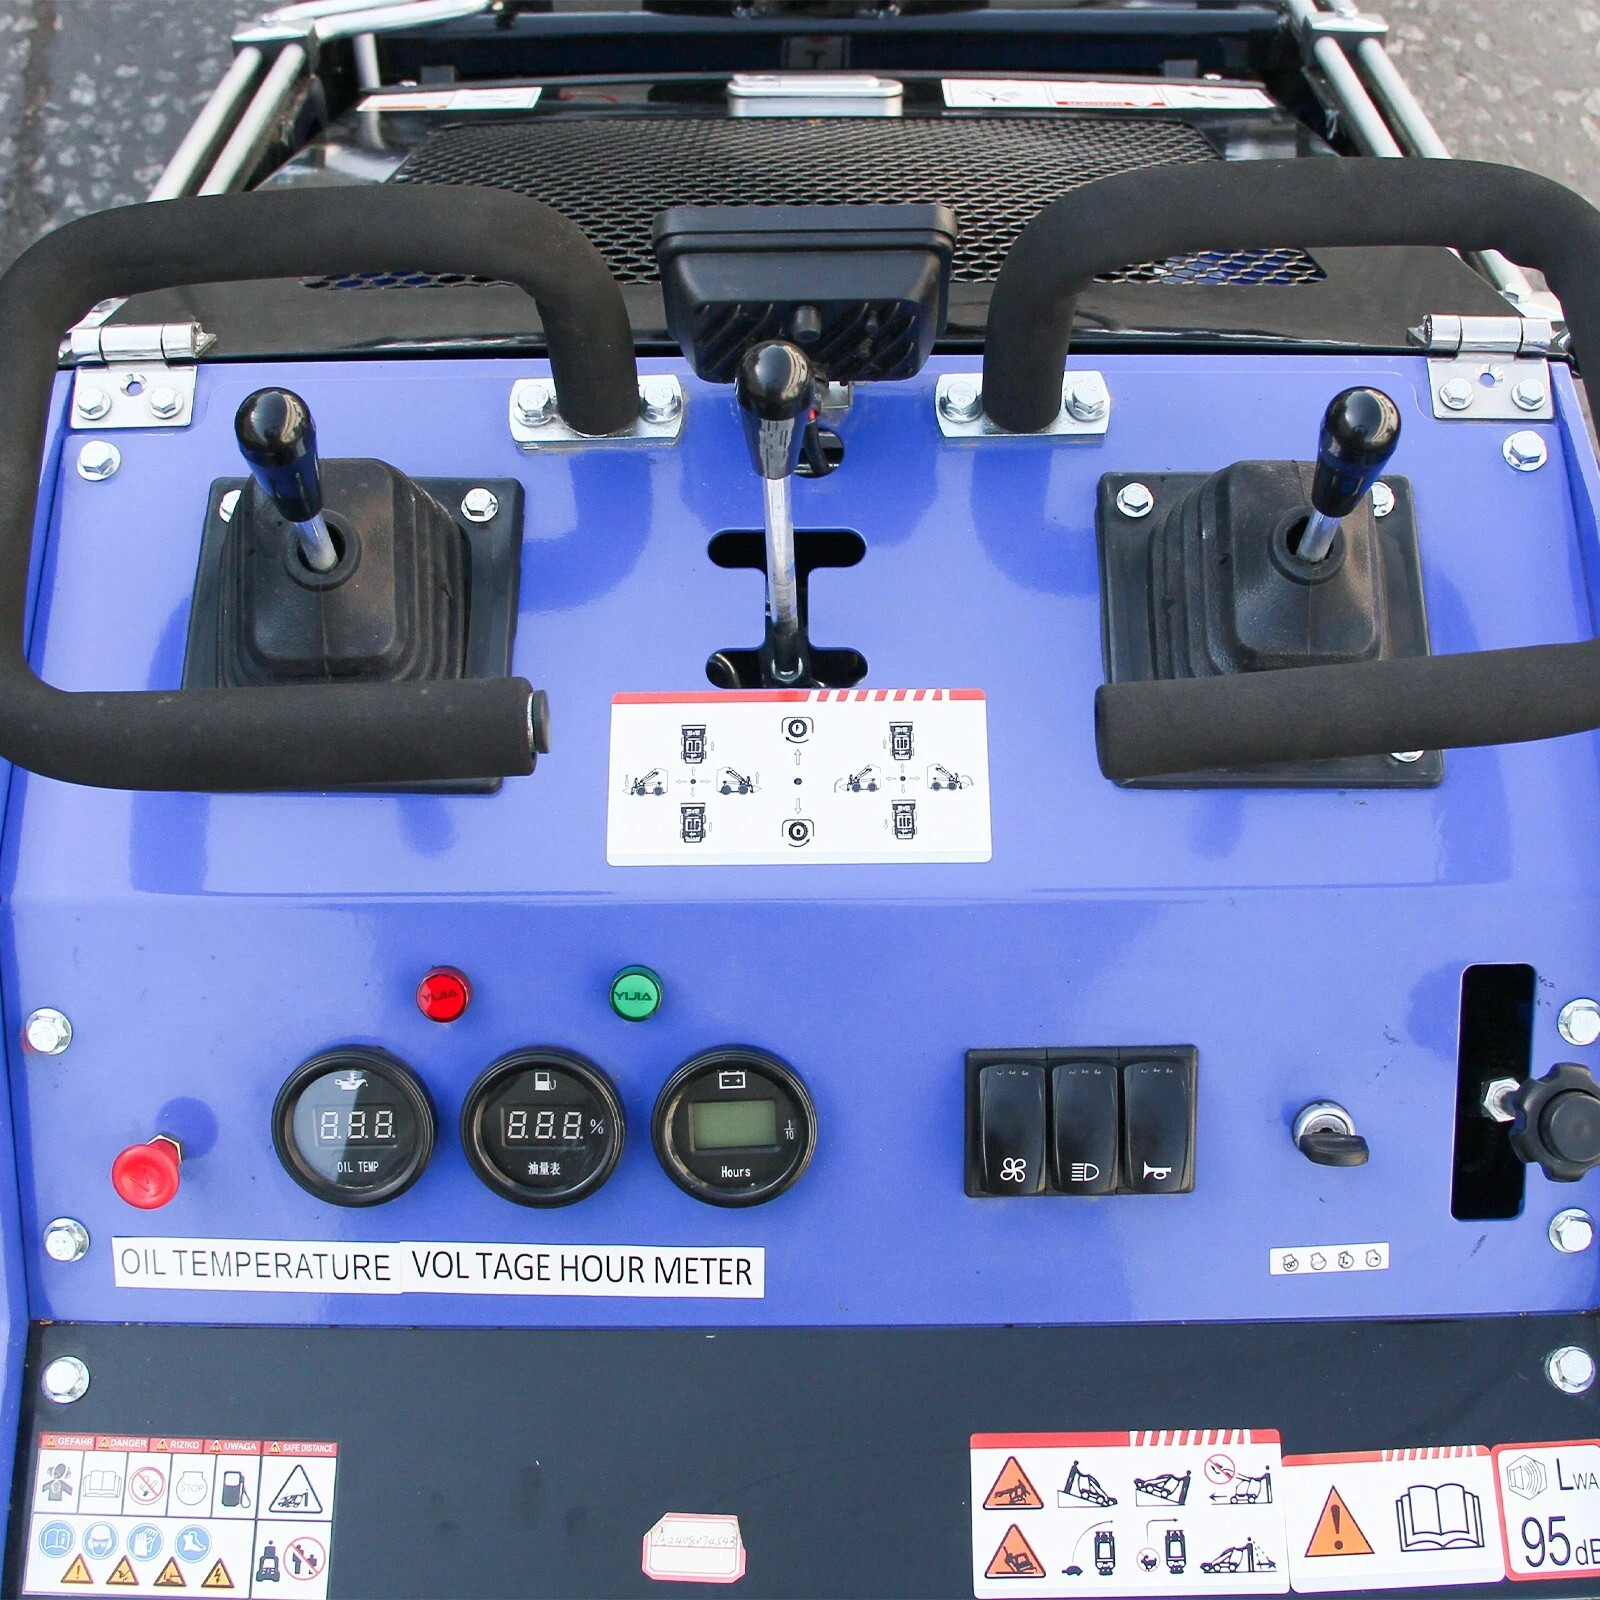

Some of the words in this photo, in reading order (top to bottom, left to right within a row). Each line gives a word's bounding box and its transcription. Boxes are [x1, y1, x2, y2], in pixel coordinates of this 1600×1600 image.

[613, 992, 653, 1001] YIJIA
[337, 1161, 354, 1173] OIL
[358, 1161, 379, 1172] TEMP
[527, 1161, 561, 1176] 油量表
[721, 1165, 751, 1178] Hours
[121, 1248, 167, 1276] OIL
[172, 1249, 391, 1281] TEMPERATURE
[560, 1254, 646, 1284] HOUR
[654, 1256, 753, 1286] METER
[57, 1436, 94, 1447] GEFAHR
[109, 1438, 148, 1448] DANGER
[169, 1440, 200, 1450] RIZIKO
[223, 1442, 257, 1452] UWAGA
[282, 1443, 300, 1453] SAFE
[301, 1444, 334, 1453] DISTANCE
[180, 1482, 205, 1494] STOP
[1521, 1515, 1571, 1568] 95
